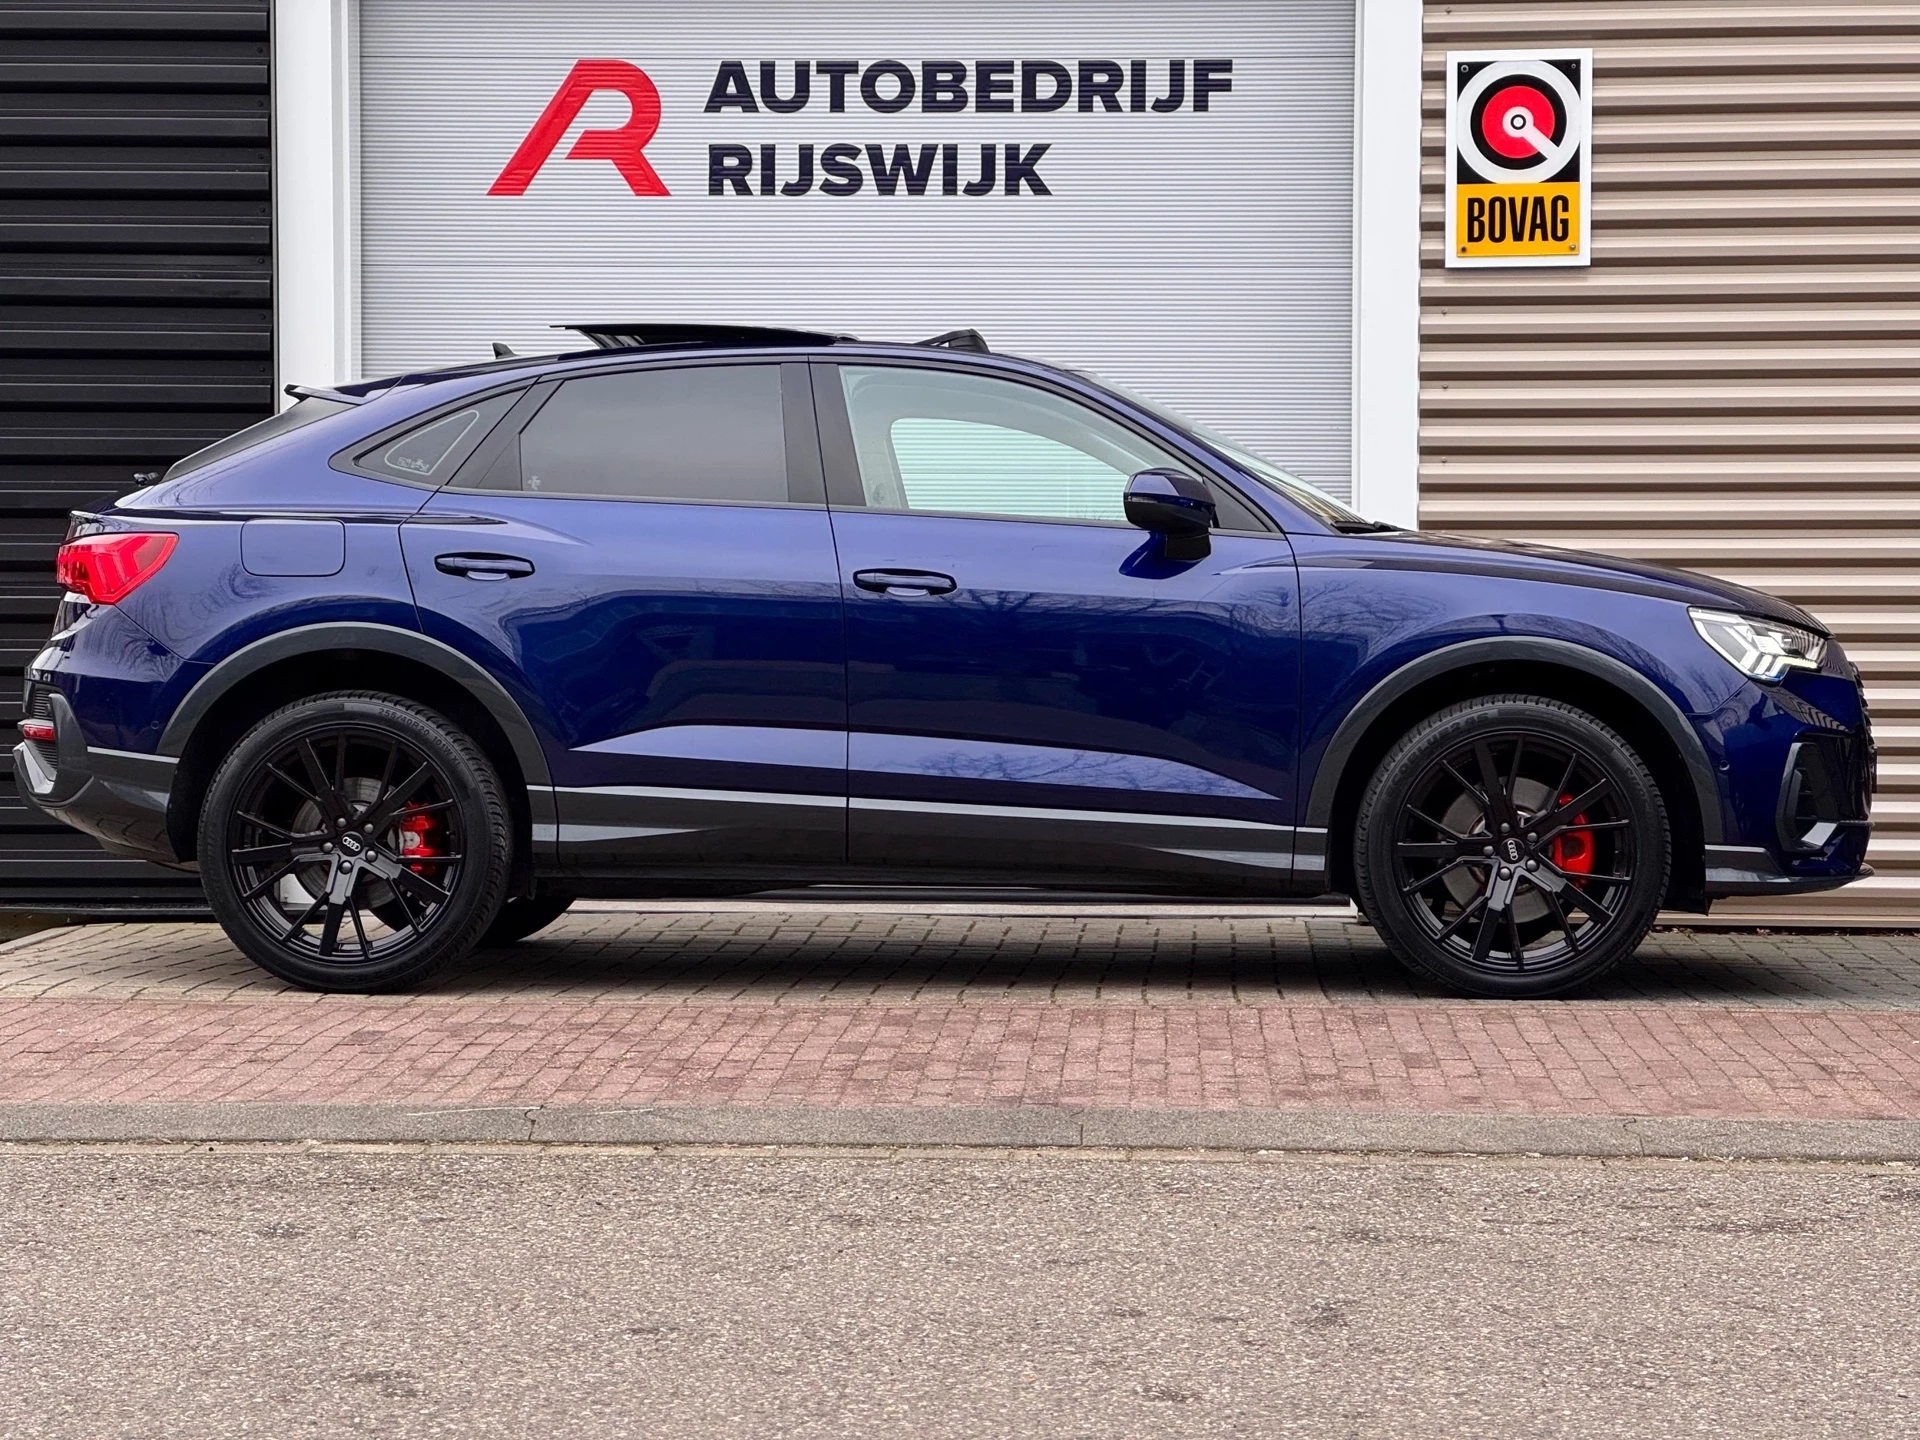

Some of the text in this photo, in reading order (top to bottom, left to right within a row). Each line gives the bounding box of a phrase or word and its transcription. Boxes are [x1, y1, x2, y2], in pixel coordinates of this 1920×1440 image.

[705, 60, 1232, 113] AUTOBEDRIJF
[709, 144, 1051, 196] RIJSWIJK
[1468, 195, 1568, 243] BOVAG
[378, 707, 430, 736] 255/40R20
[432, 736, 454, 757] 101W
